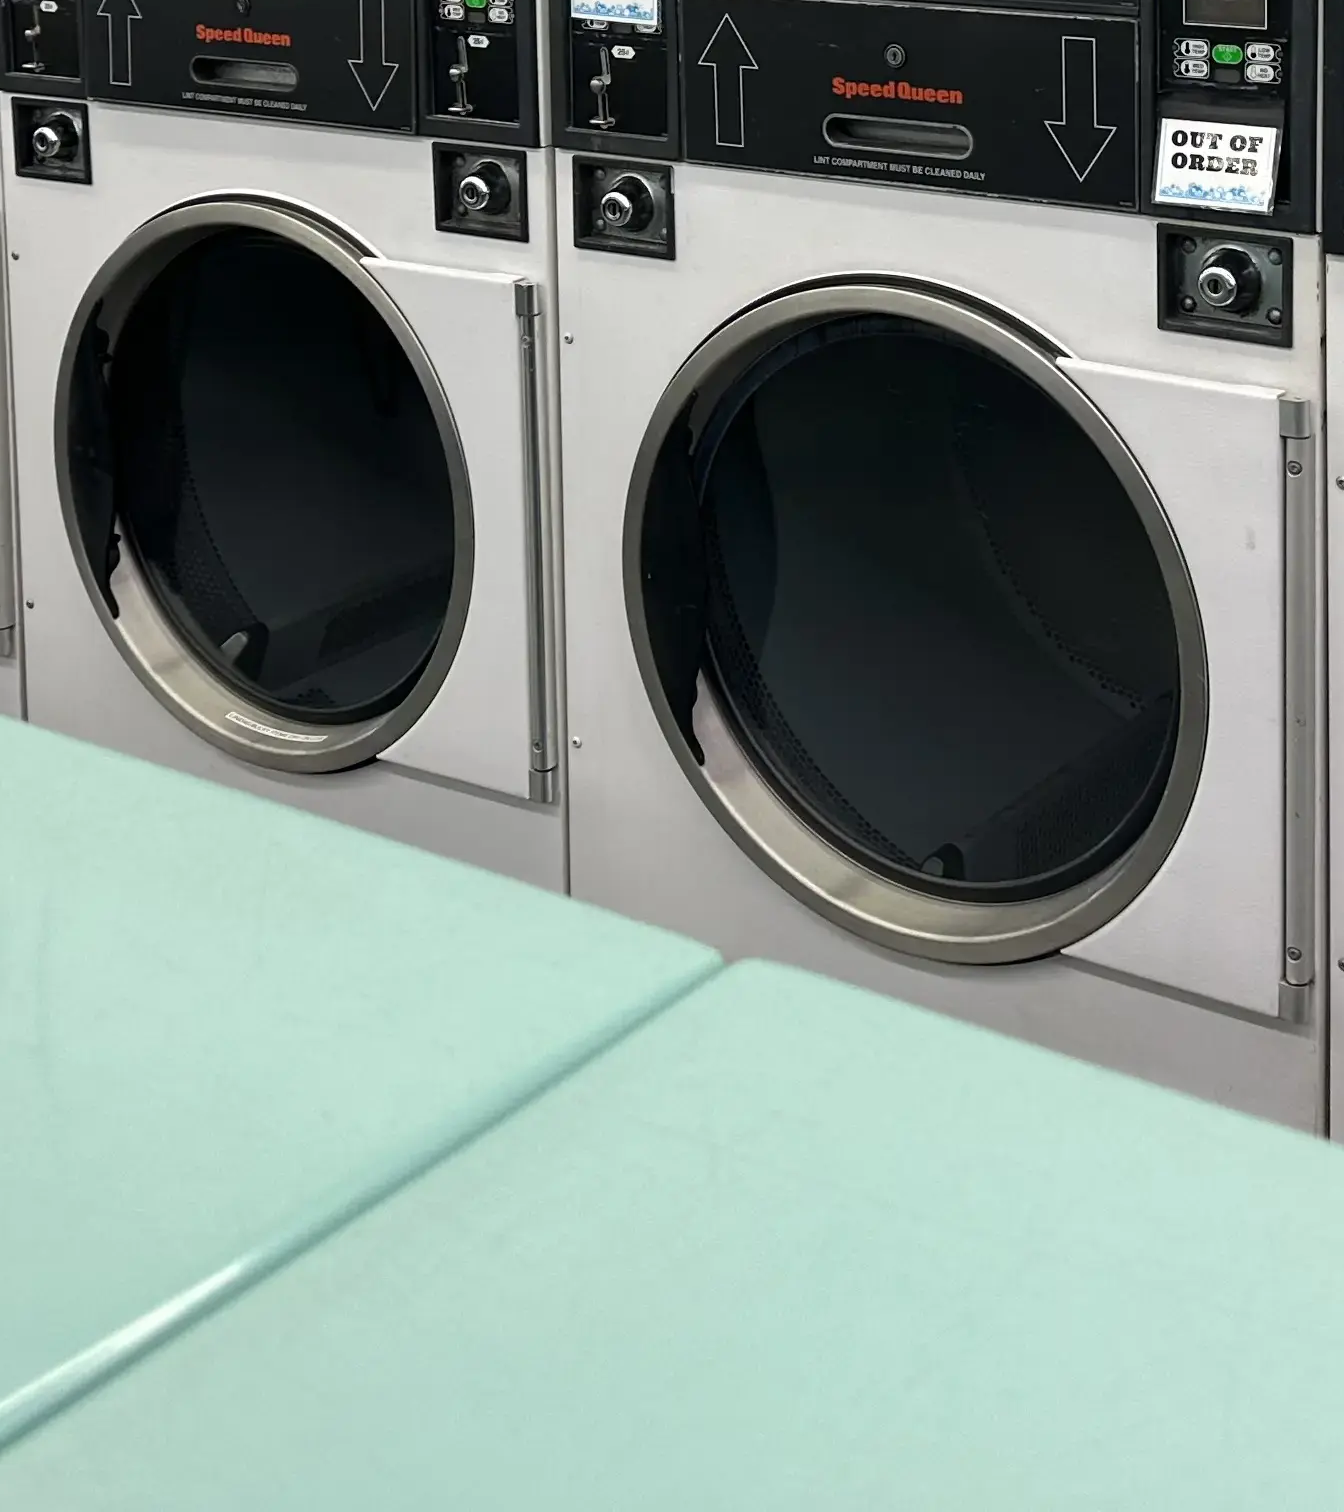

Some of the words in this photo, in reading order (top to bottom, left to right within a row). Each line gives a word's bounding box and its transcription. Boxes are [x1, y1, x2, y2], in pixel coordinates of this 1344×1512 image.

[196, 24, 242, 43] Speed
[244, 28, 291, 46] Queen
[832, 77, 896, 98] Speed
[898, 82, 963, 104] Queen
[1171, 130, 1223, 150] OUT
[1230, 135, 1263, 152] OF
[813, 156, 830, 164] LINT
[832, 157, 887, 170] COMPARTMENT
[889, 163, 911, 173] MUST
[913, 166, 923, 174] BE
[925, 167, 961, 178] CLEANED
[963, 171, 986, 180] DAILY
[1171, 152, 1258, 176] ORDER
